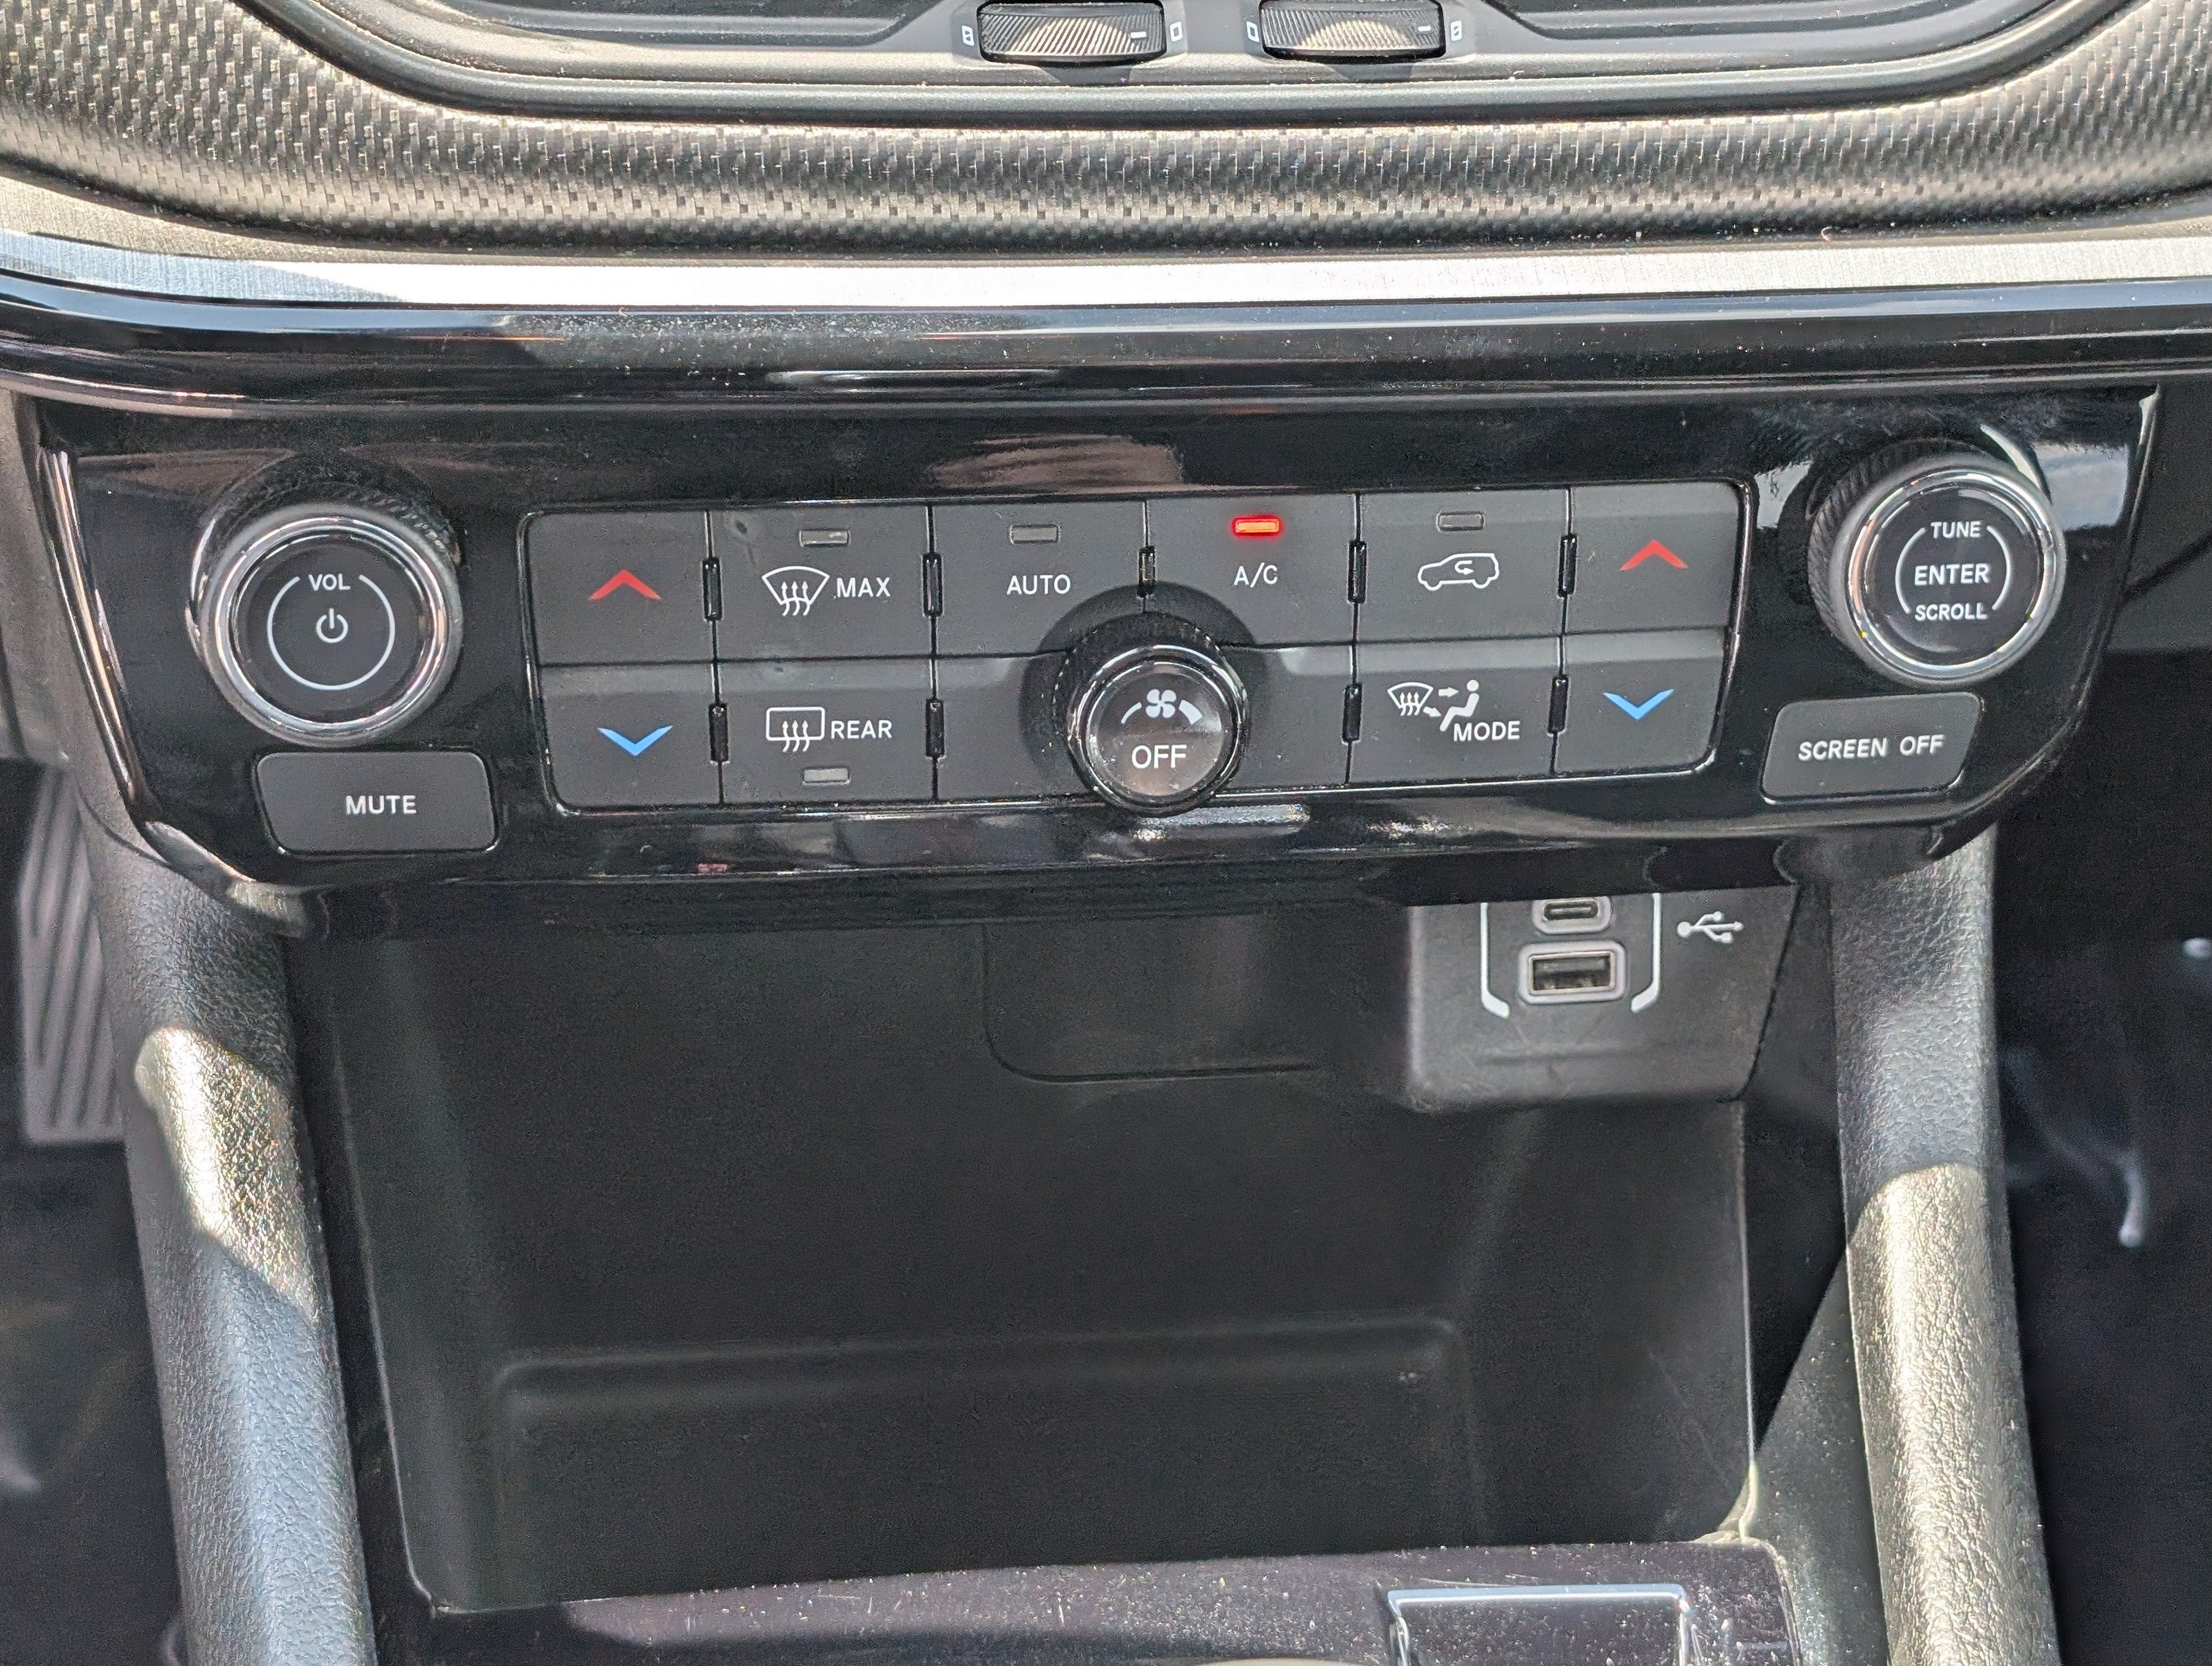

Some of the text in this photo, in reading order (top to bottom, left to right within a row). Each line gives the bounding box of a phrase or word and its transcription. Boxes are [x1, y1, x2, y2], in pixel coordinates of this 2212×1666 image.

[1930, 521, 1981, 539] TUNE
[308, 573, 351, 591] VOL
[1006, 574, 1071, 595] AUTO
[1233, 562, 1278, 588] A/C
[1914, 563, 1990, 586] ENTER
[837, 577, 891, 598] MAX
[1914, 603, 1987, 621] SCROLL
[831, 720, 892, 739] REAR
[1454, 720, 1520, 741] MODE
[1131, 744, 1187, 769] OFF
[1798, 734, 1944, 761] SCREEN OFF
[345, 795, 417, 815] MUTE
